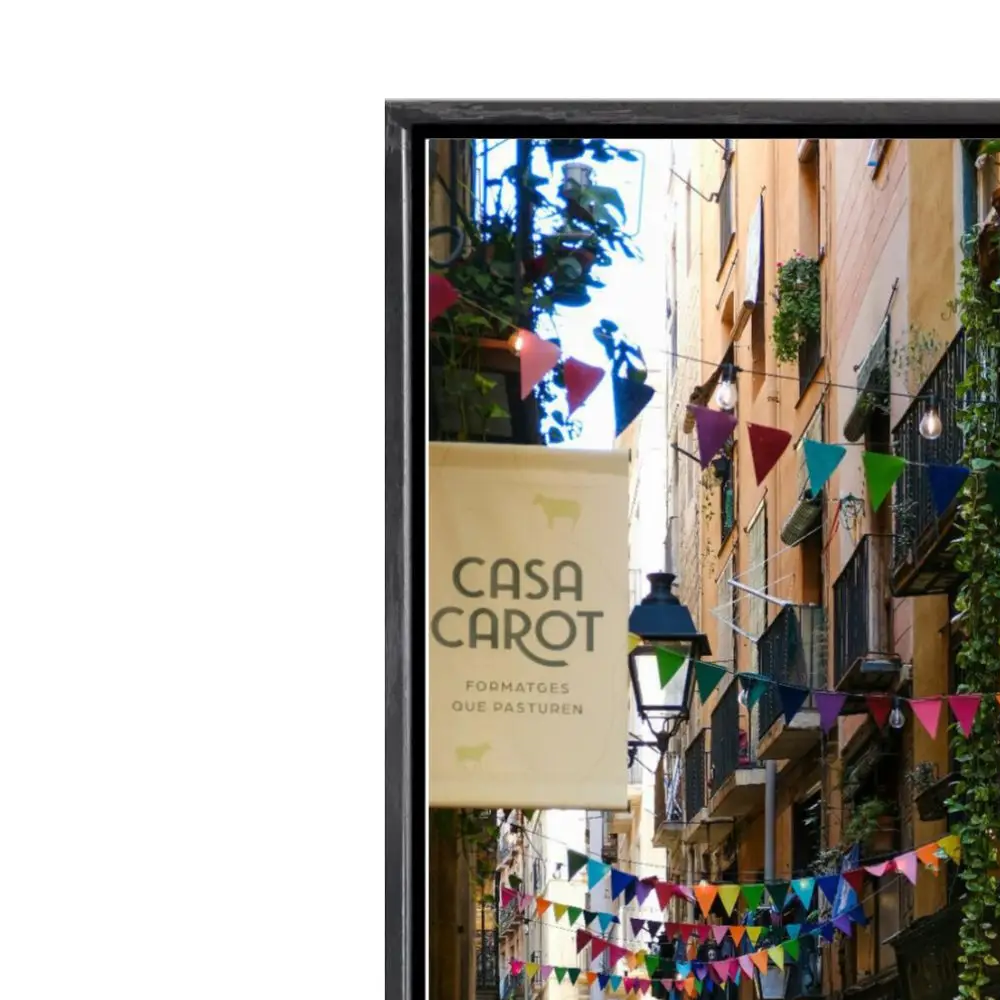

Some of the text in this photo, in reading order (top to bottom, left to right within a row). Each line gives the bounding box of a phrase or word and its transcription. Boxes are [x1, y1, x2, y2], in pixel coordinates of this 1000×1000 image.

[452, 556, 583, 602] CASA
[431, 606, 604, 667] CAROT
[465, 679, 570, 695] FORMATGES
[451, 700, 584, 716] QUE PASTUREN
